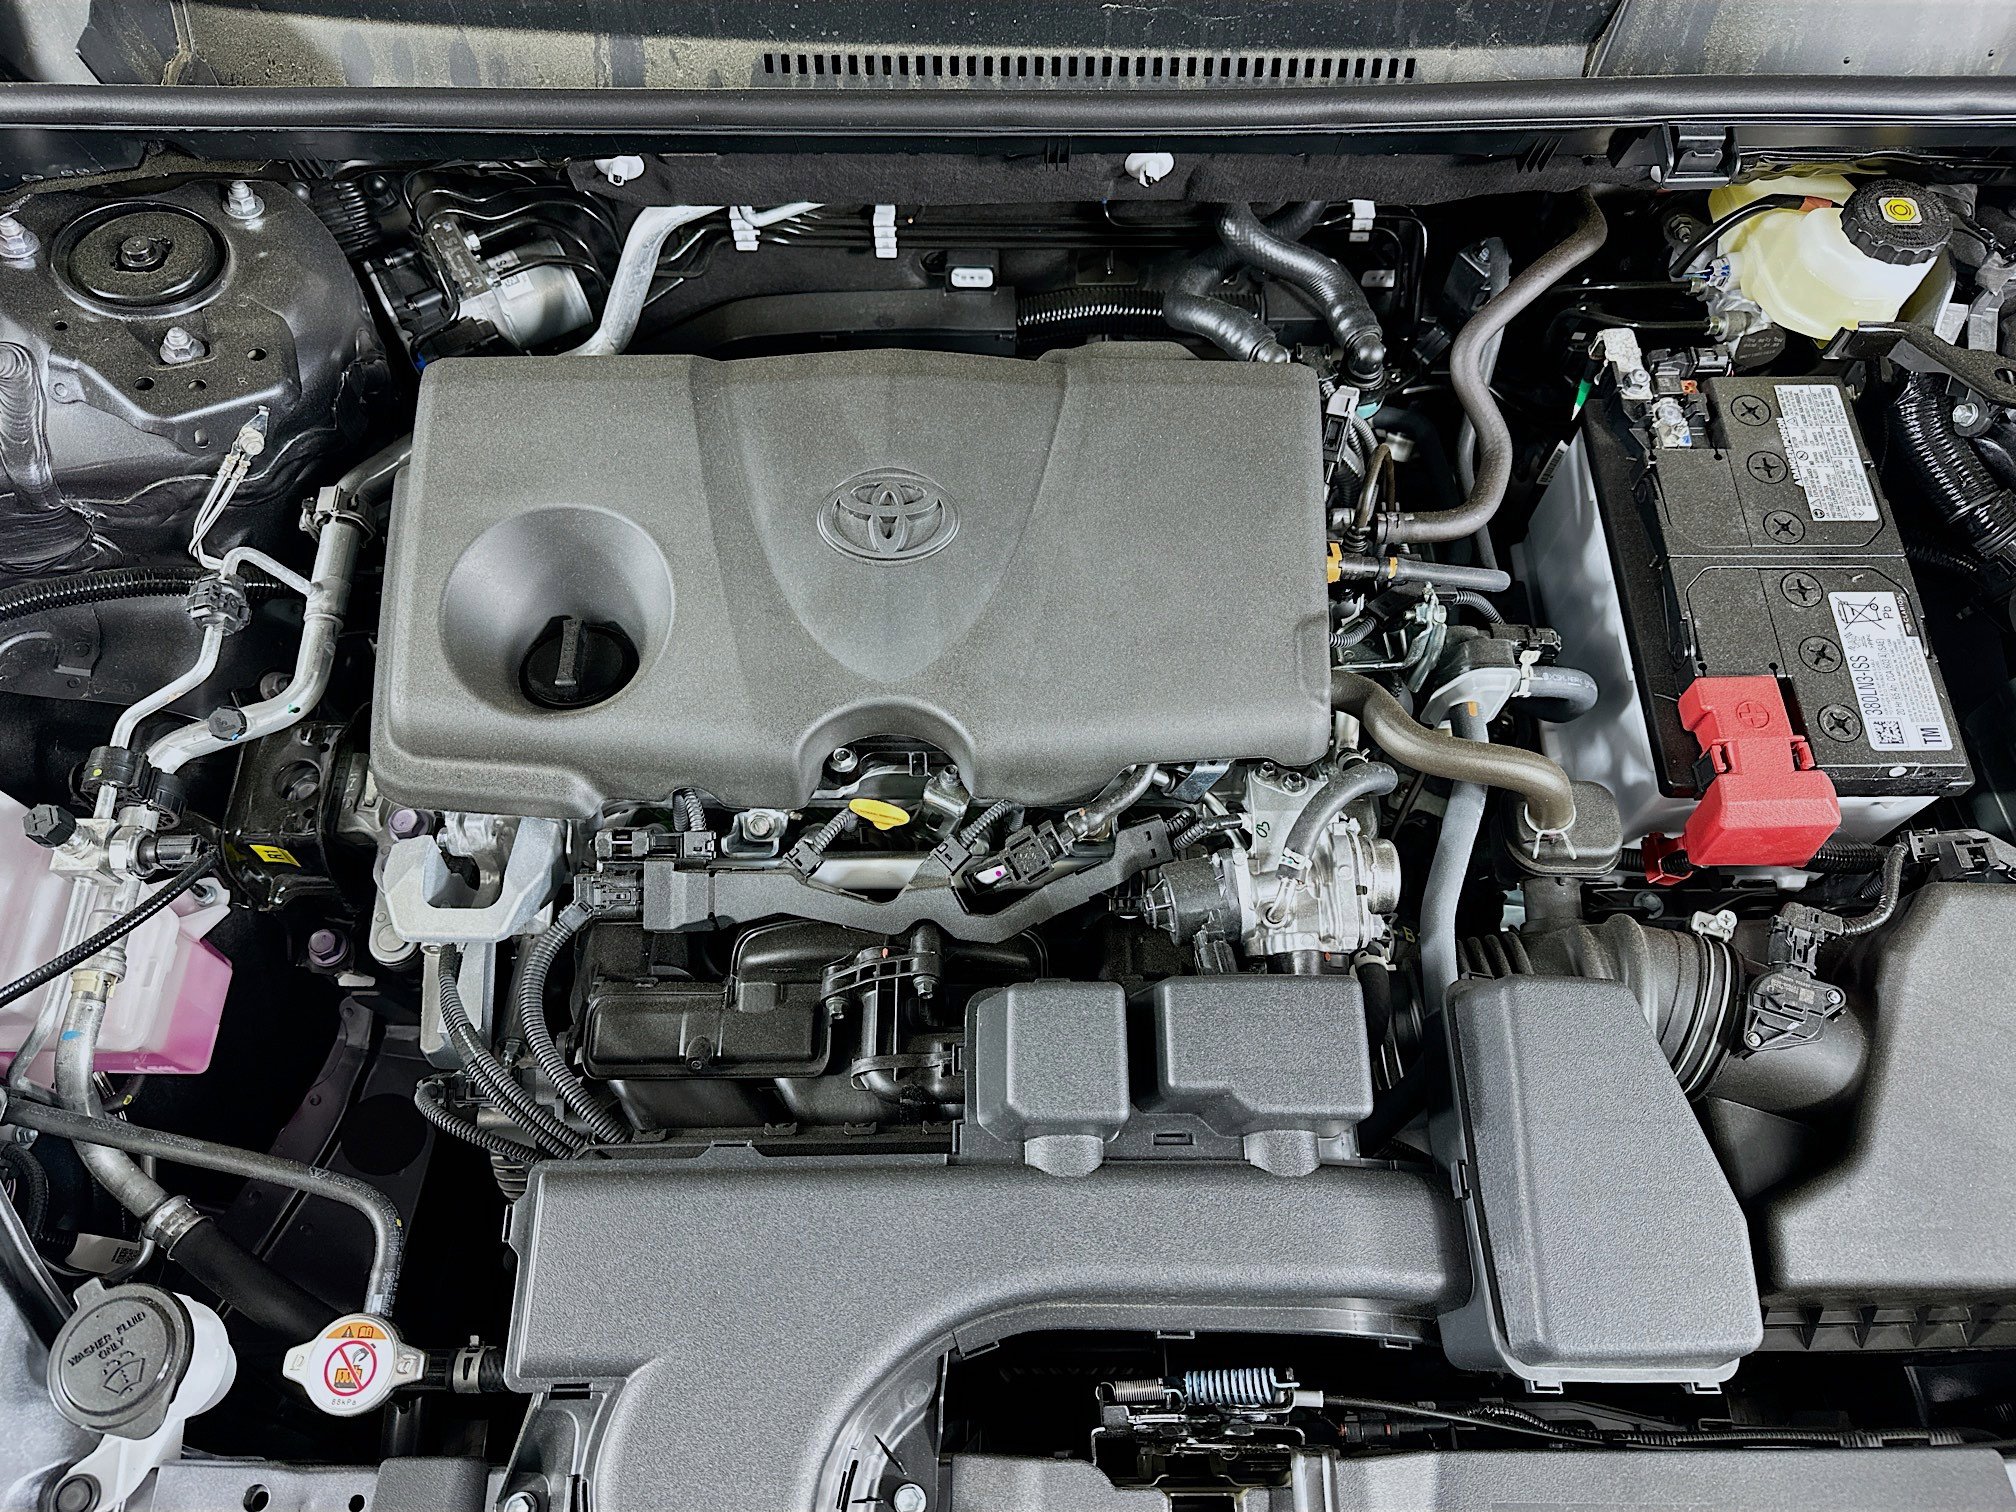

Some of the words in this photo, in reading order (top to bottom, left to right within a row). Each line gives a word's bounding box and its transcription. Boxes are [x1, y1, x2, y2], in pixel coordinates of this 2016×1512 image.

[1883, 606, 1894, 619] Pb
[1850, 655, 1883, 715] 380LN3-ISS
[1920, 727, 1942, 744] TM
[67, 1334, 112, 1367] WASHER
[115, 1311, 146, 1336] FLUID
[98, 1337, 125, 1360] ONLY
